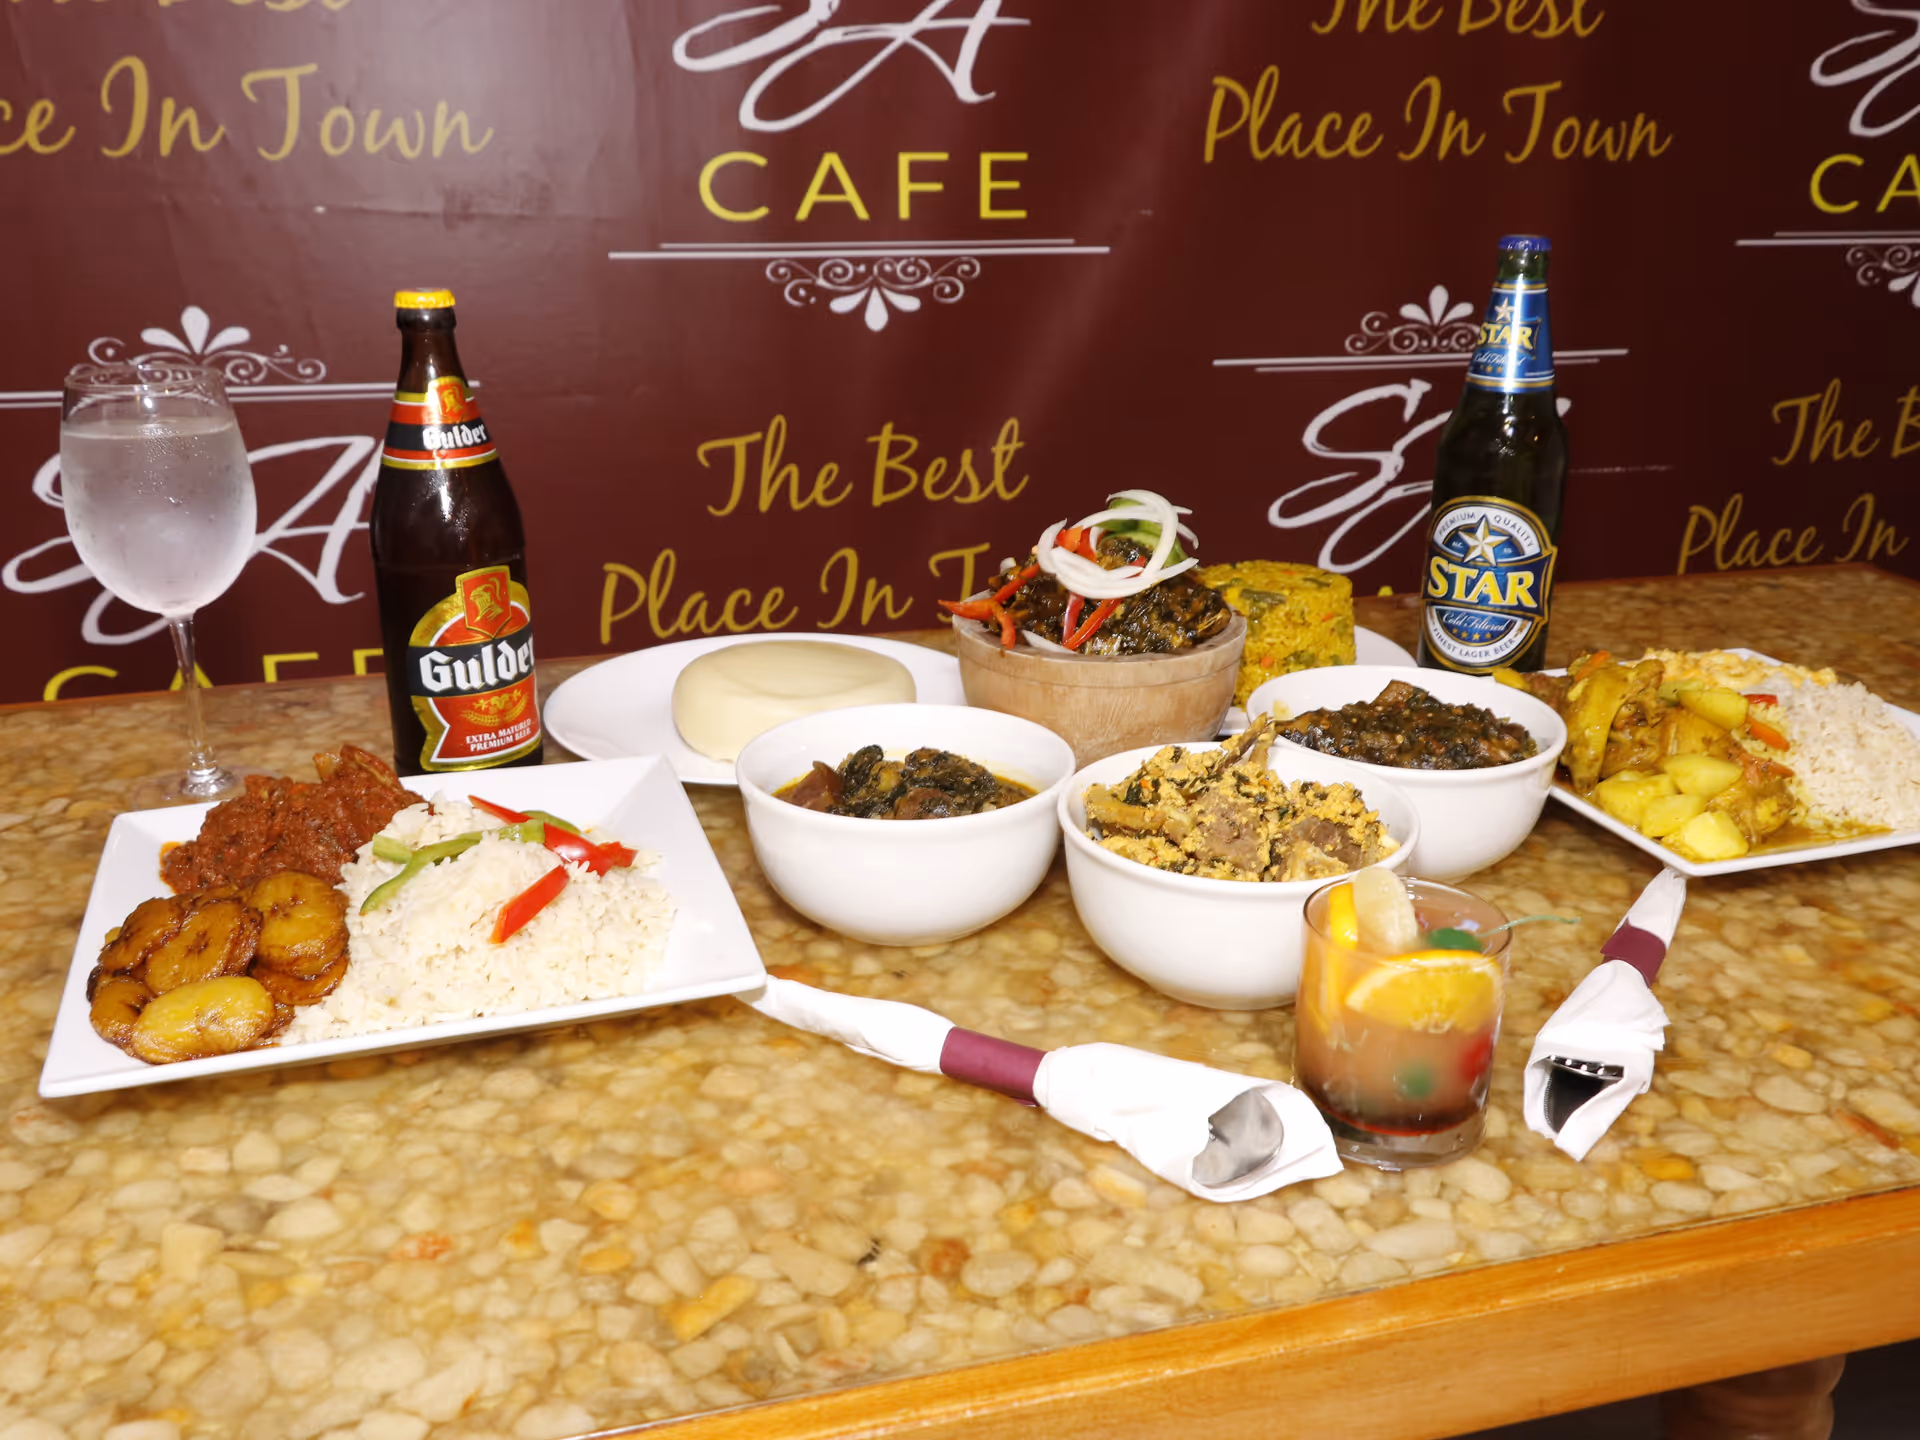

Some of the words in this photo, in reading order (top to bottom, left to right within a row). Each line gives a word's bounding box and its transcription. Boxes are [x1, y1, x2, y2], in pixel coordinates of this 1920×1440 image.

[101, 56, 225, 157] In
[241, 63, 494, 161] Town
[1204, 64, 1384, 164] Place
[1397, 75, 1487, 161] In
[1503, 79, 1673, 164] Town
[698, 151, 1029, 221] CAFE
[1810, 153, 1920, 214] CA
[1477, 322, 1534, 350] STAR
[422, 422, 488, 450] Gulder
[1771, 378, 1880, 465] The
[697, 414, 853, 517] The
[866, 417, 1029, 507] Best
[1438, 511, 1476, 536] PREMIUM
[1493, 514, 1534, 548] QUALITY
[1677, 493, 1824, 575] Place
[1835, 492, 1909, 562] In
[600, 548, 799, 645] Place
[816, 547, 914, 629] In
[1427, 556, 1538, 608] STAR
[1433, 627, 1457, 653] FINEST
[1459, 648, 1490, 658] LAGER
[1493, 637, 1517, 655] BEER
[1442, 611, 1468, 628] Cold
[466, 731, 497, 744] EXTRA
[498, 718, 532, 737] MATURED
[470, 735, 514, 752] PREMIUM
[514, 727, 531, 741] BEER
